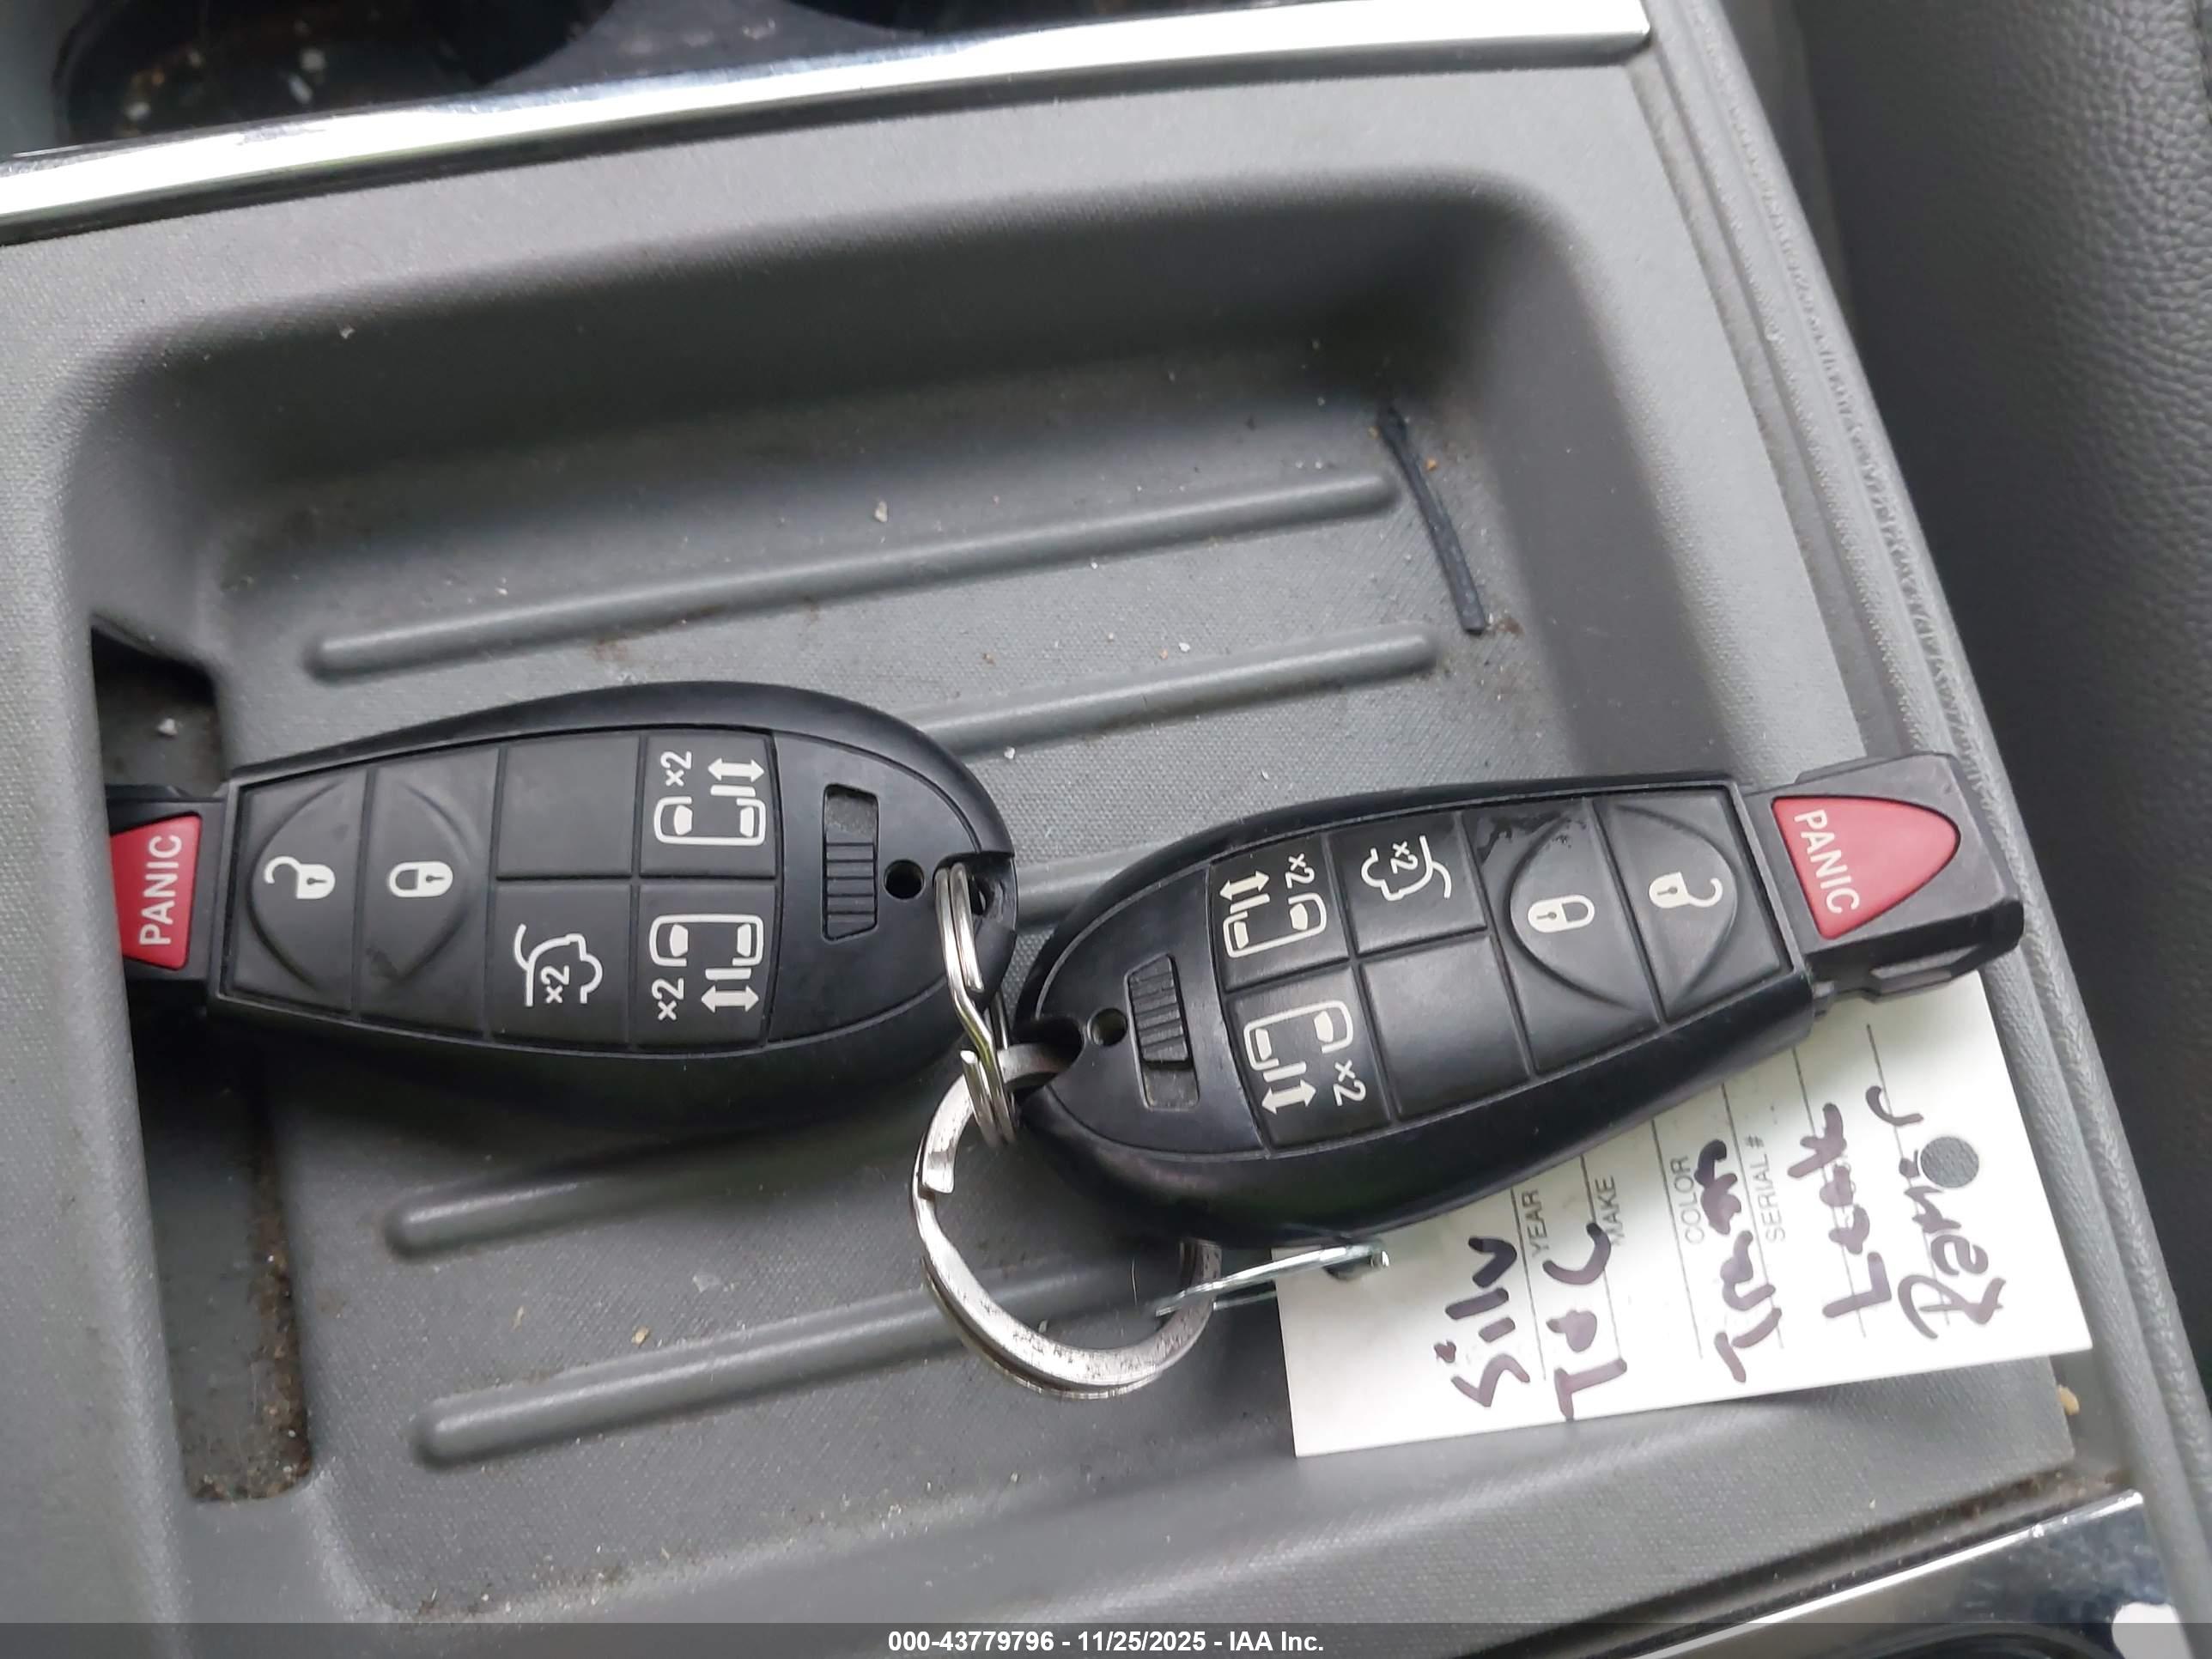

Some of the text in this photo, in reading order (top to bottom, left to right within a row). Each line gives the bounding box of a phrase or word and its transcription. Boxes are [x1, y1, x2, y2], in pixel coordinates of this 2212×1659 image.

[139, 835, 182, 945] PANIC
[1794, 810, 1860, 914] PANIC
[1522, 1188, 1549, 1257] YEAR
[1595, 1175, 1625, 1247] MAKE
[1670, 1155, 1705, 1244] COLOR
[1744, 1134, 1785, 1243] SERIAL #
